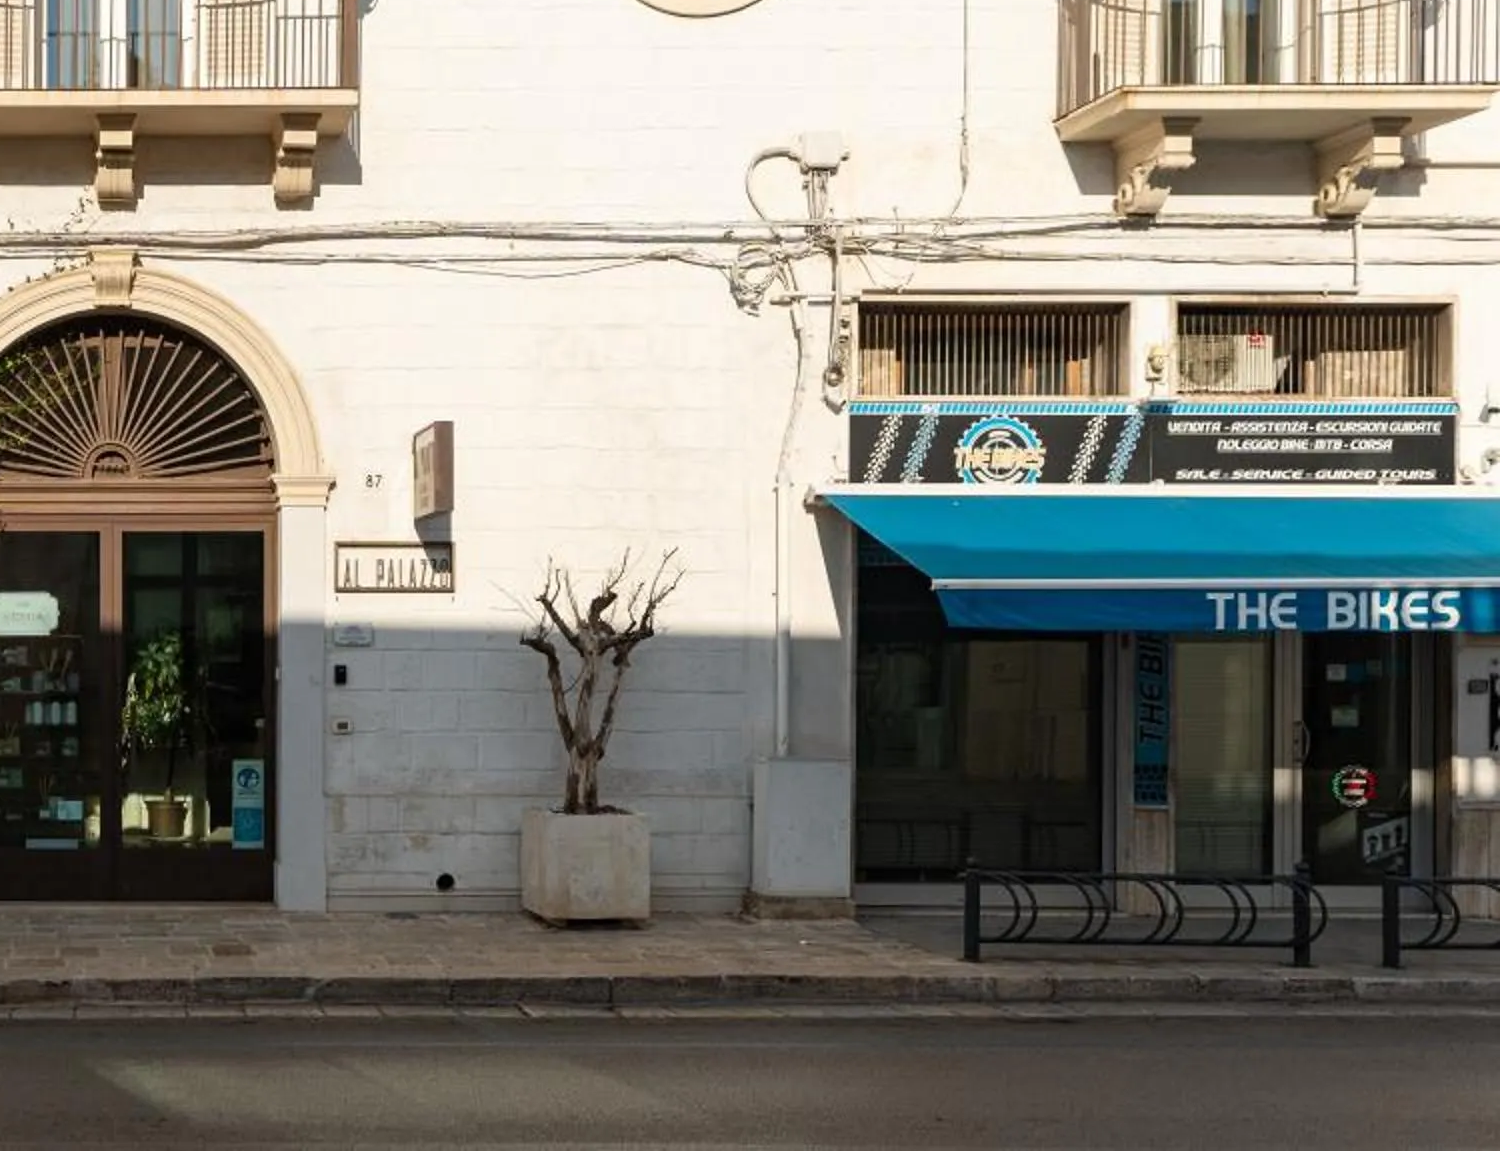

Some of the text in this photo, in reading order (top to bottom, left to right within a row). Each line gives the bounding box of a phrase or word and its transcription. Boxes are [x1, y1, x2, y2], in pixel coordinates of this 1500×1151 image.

[1167, 421, 1442, 433] VENDITA ASSISTENZA ESCURSIONI GUIDATE
[1217, 438, 1279, 450] NOLEGGIO
[1314, 438, 1342, 450] MTB
[1349, 438, 1393, 450] CORSA
[954, 447, 992, 469] THE
[365, 475, 382, 488] 87
[1175, 469, 1437, 480] SALE SERVICE GUIDED TOURS
[343, 557, 451, 589] AL PALAZZO
[1205, 590, 1462, 631] THE BIKES
[1139, 681, 1165, 745] THE
